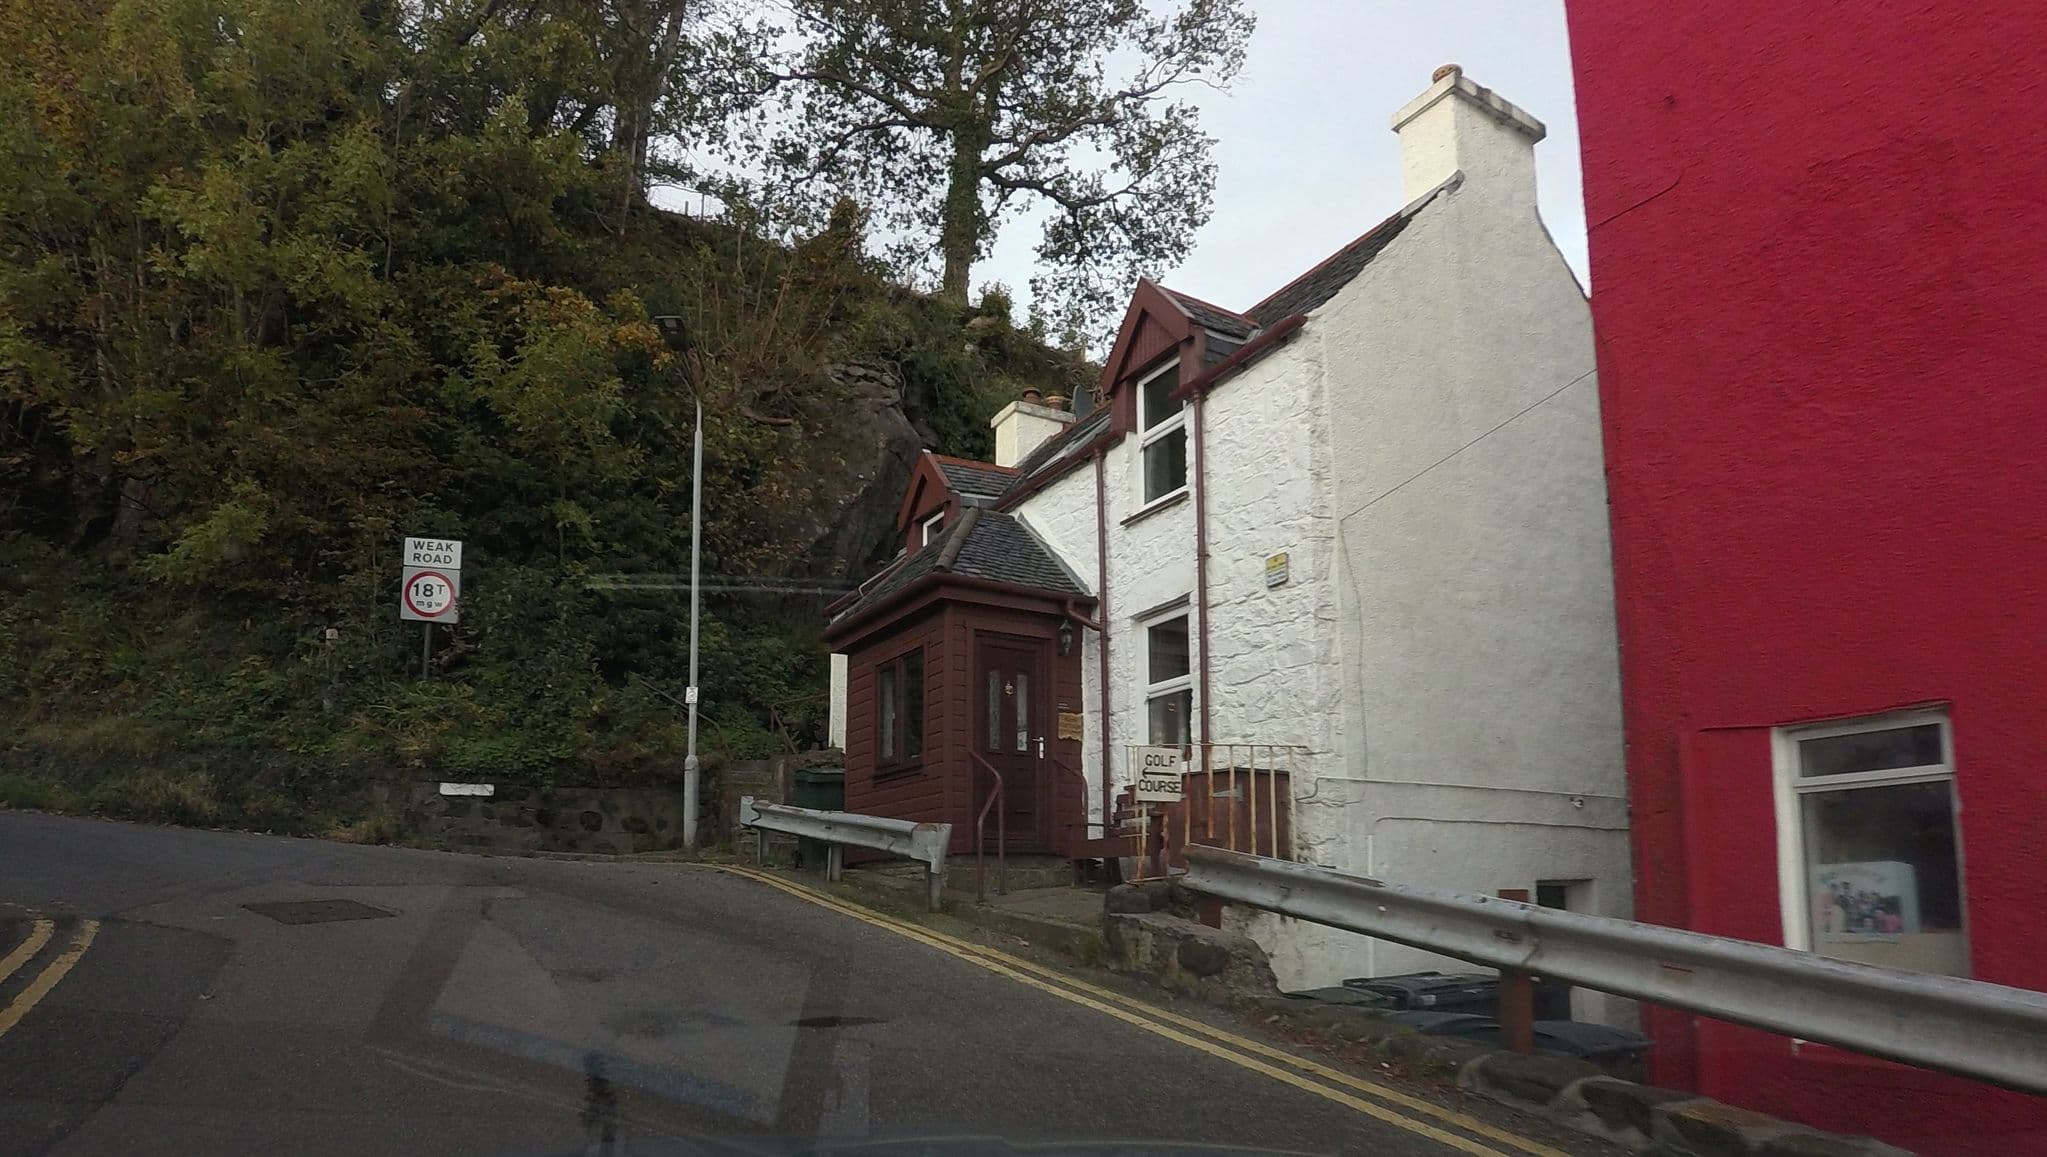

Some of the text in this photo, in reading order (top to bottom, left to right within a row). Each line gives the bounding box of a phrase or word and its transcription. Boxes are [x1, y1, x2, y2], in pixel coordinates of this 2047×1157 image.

[413, 540, 454, 552] WEAK
[413, 553, 452, 564] ROAD
[414, 583, 445, 597] 18T
[1145, 754, 1176, 767] GOLF
[1138, 779, 1182, 794] COURSE
